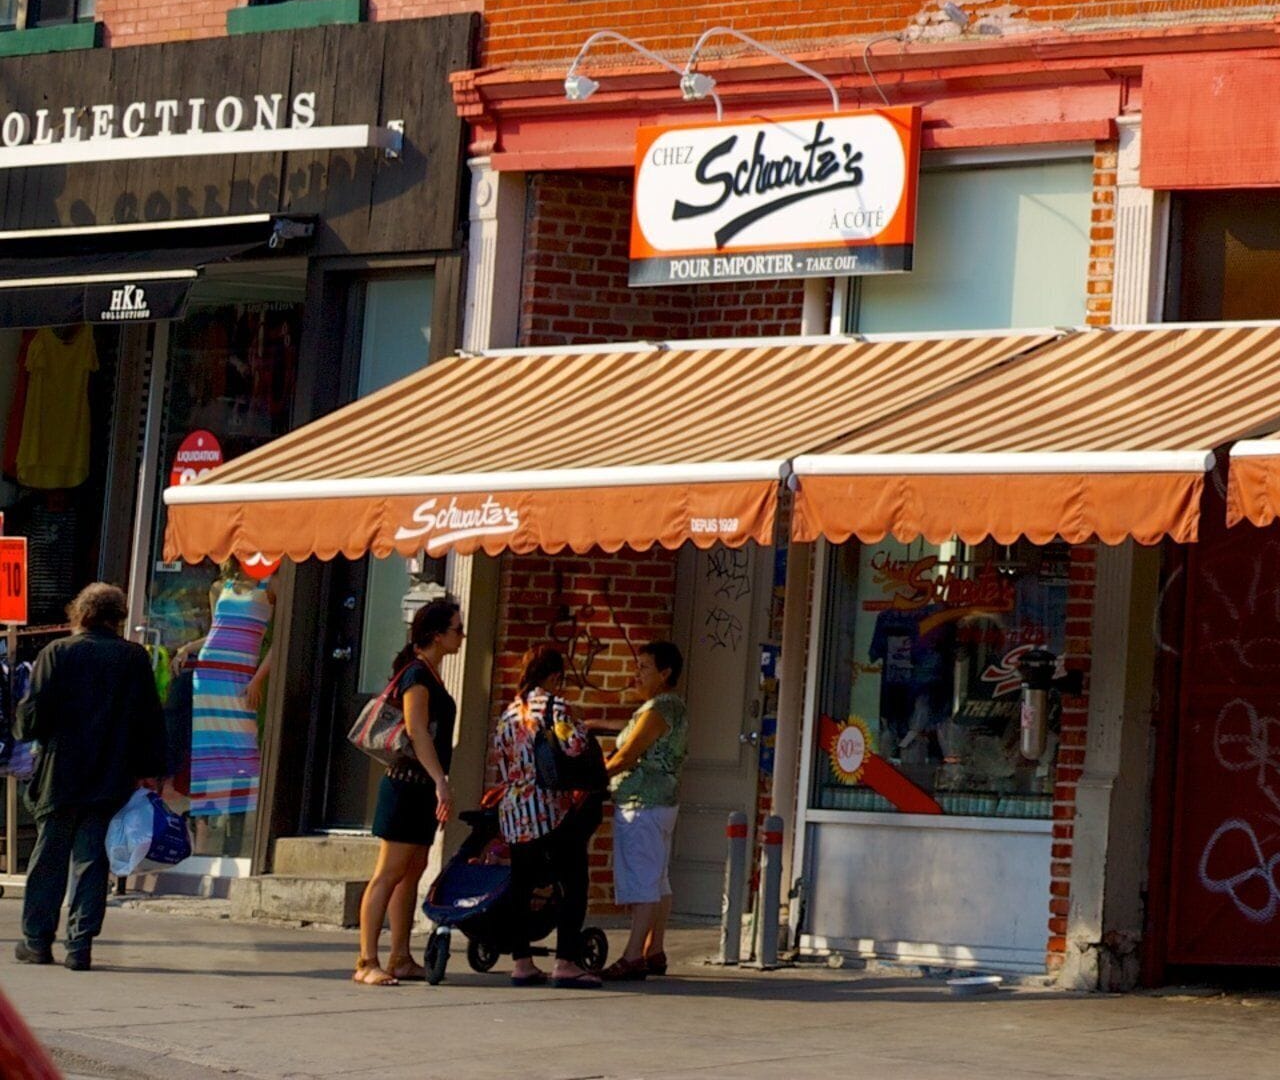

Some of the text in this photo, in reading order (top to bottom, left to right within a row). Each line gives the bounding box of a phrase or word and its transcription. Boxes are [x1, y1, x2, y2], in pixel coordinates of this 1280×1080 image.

[652, 120, 864, 250] CHEZ Schwartz's
[669, 259, 710, 279] POUR
[713, 254, 794, 277] EMPORTER
[805, 257, 833, 272] TAKE
[834, 255, 858, 270] OUT
[101, 308, 150, 321] COLLECTIONS
[177, 449, 220, 462] LIQUIDATION
[691, 518, 718, 532] DEPUIS
